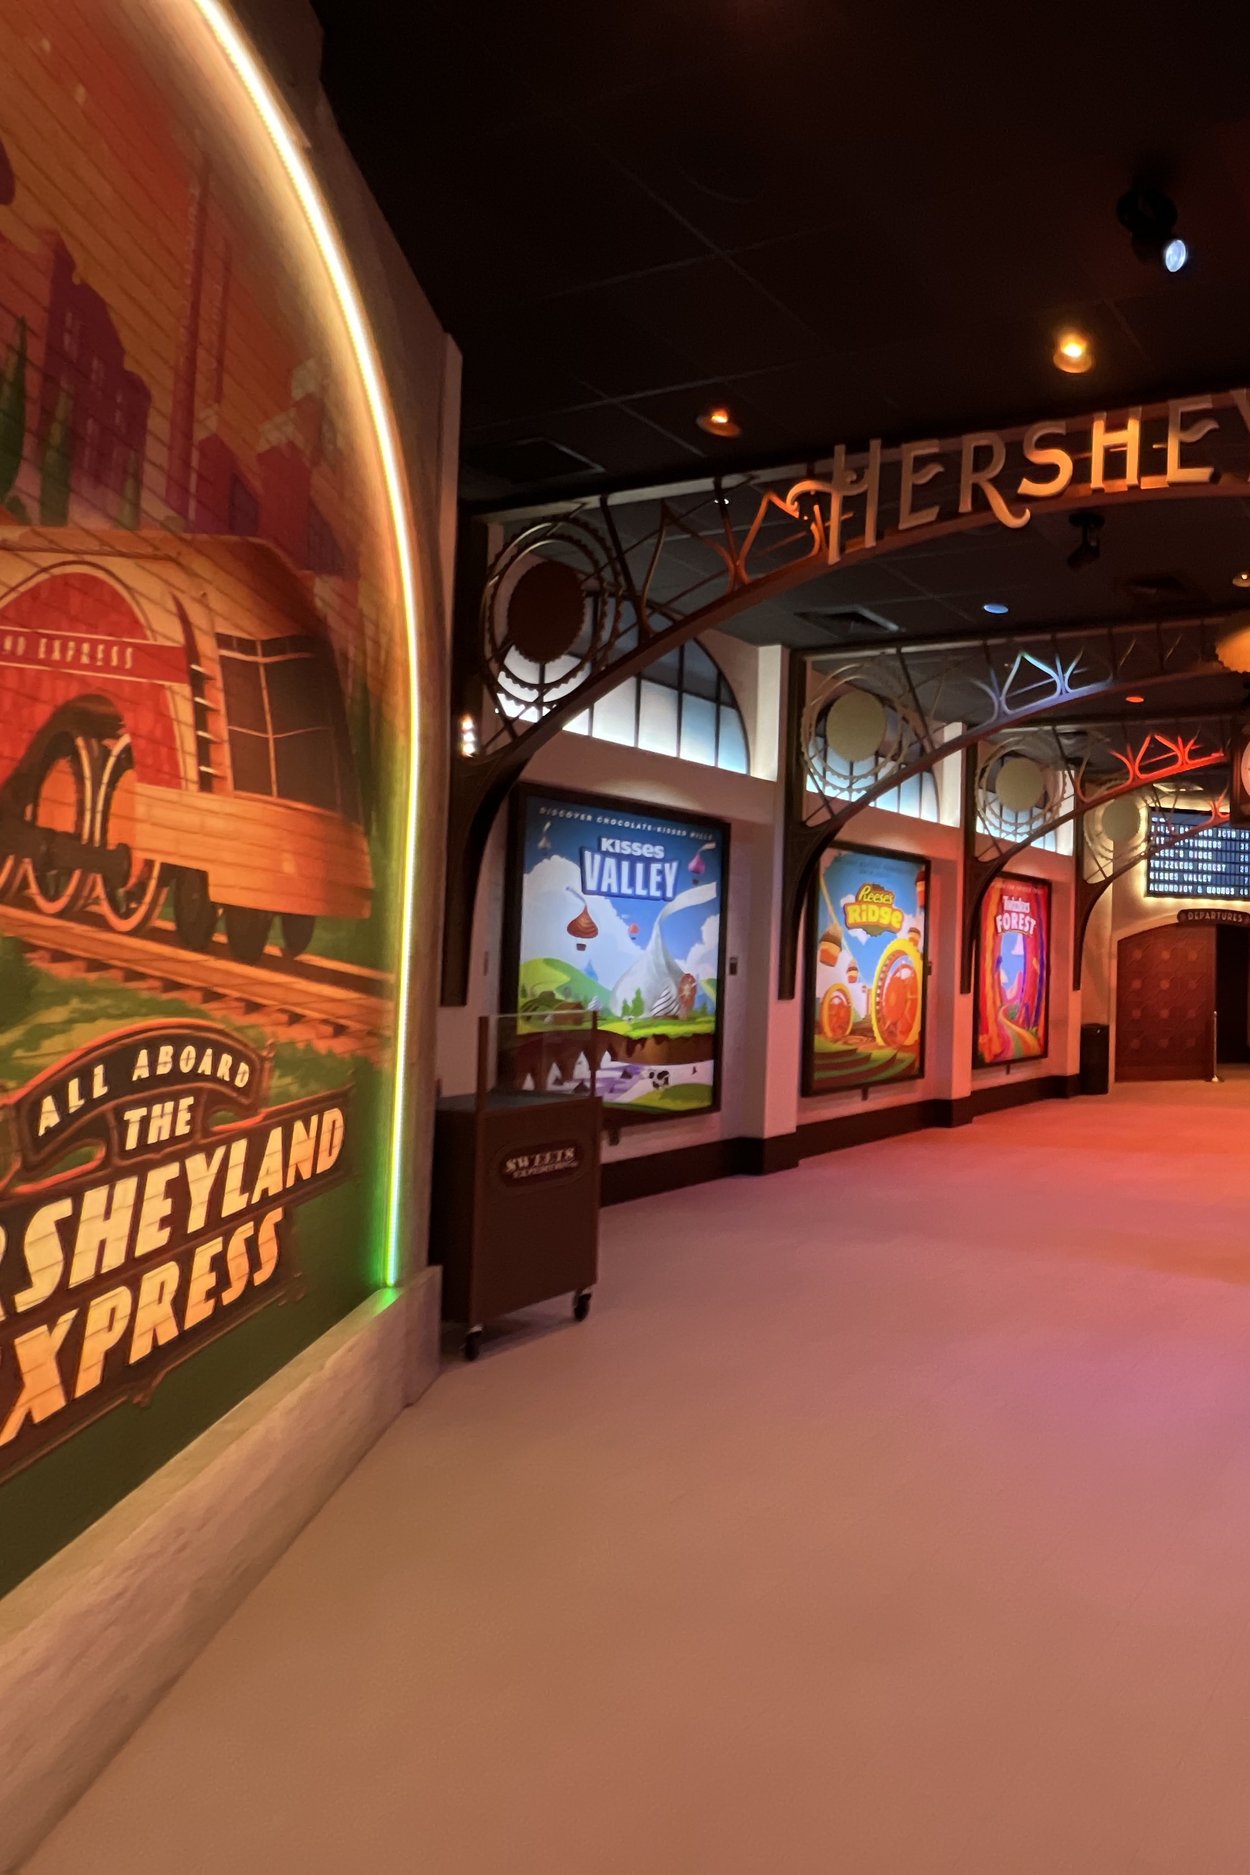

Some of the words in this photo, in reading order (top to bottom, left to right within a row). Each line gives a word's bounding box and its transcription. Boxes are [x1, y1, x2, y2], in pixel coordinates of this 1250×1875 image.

[38, 638, 133, 669] EXPRESS
[584, 850, 678, 898] VALLEY
[1184, 874, 1212, 882] VALLEY
[1198, 863, 1226, 872] FOREST
[996, 912, 1036, 935] FOREST
[1188, 912, 1243, 923] DEPARTURES
[38, 1065, 108, 1136] ALL
[132, 1045, 250, 1088] ABOARD
[124, 1096, 194, 1150] THE
